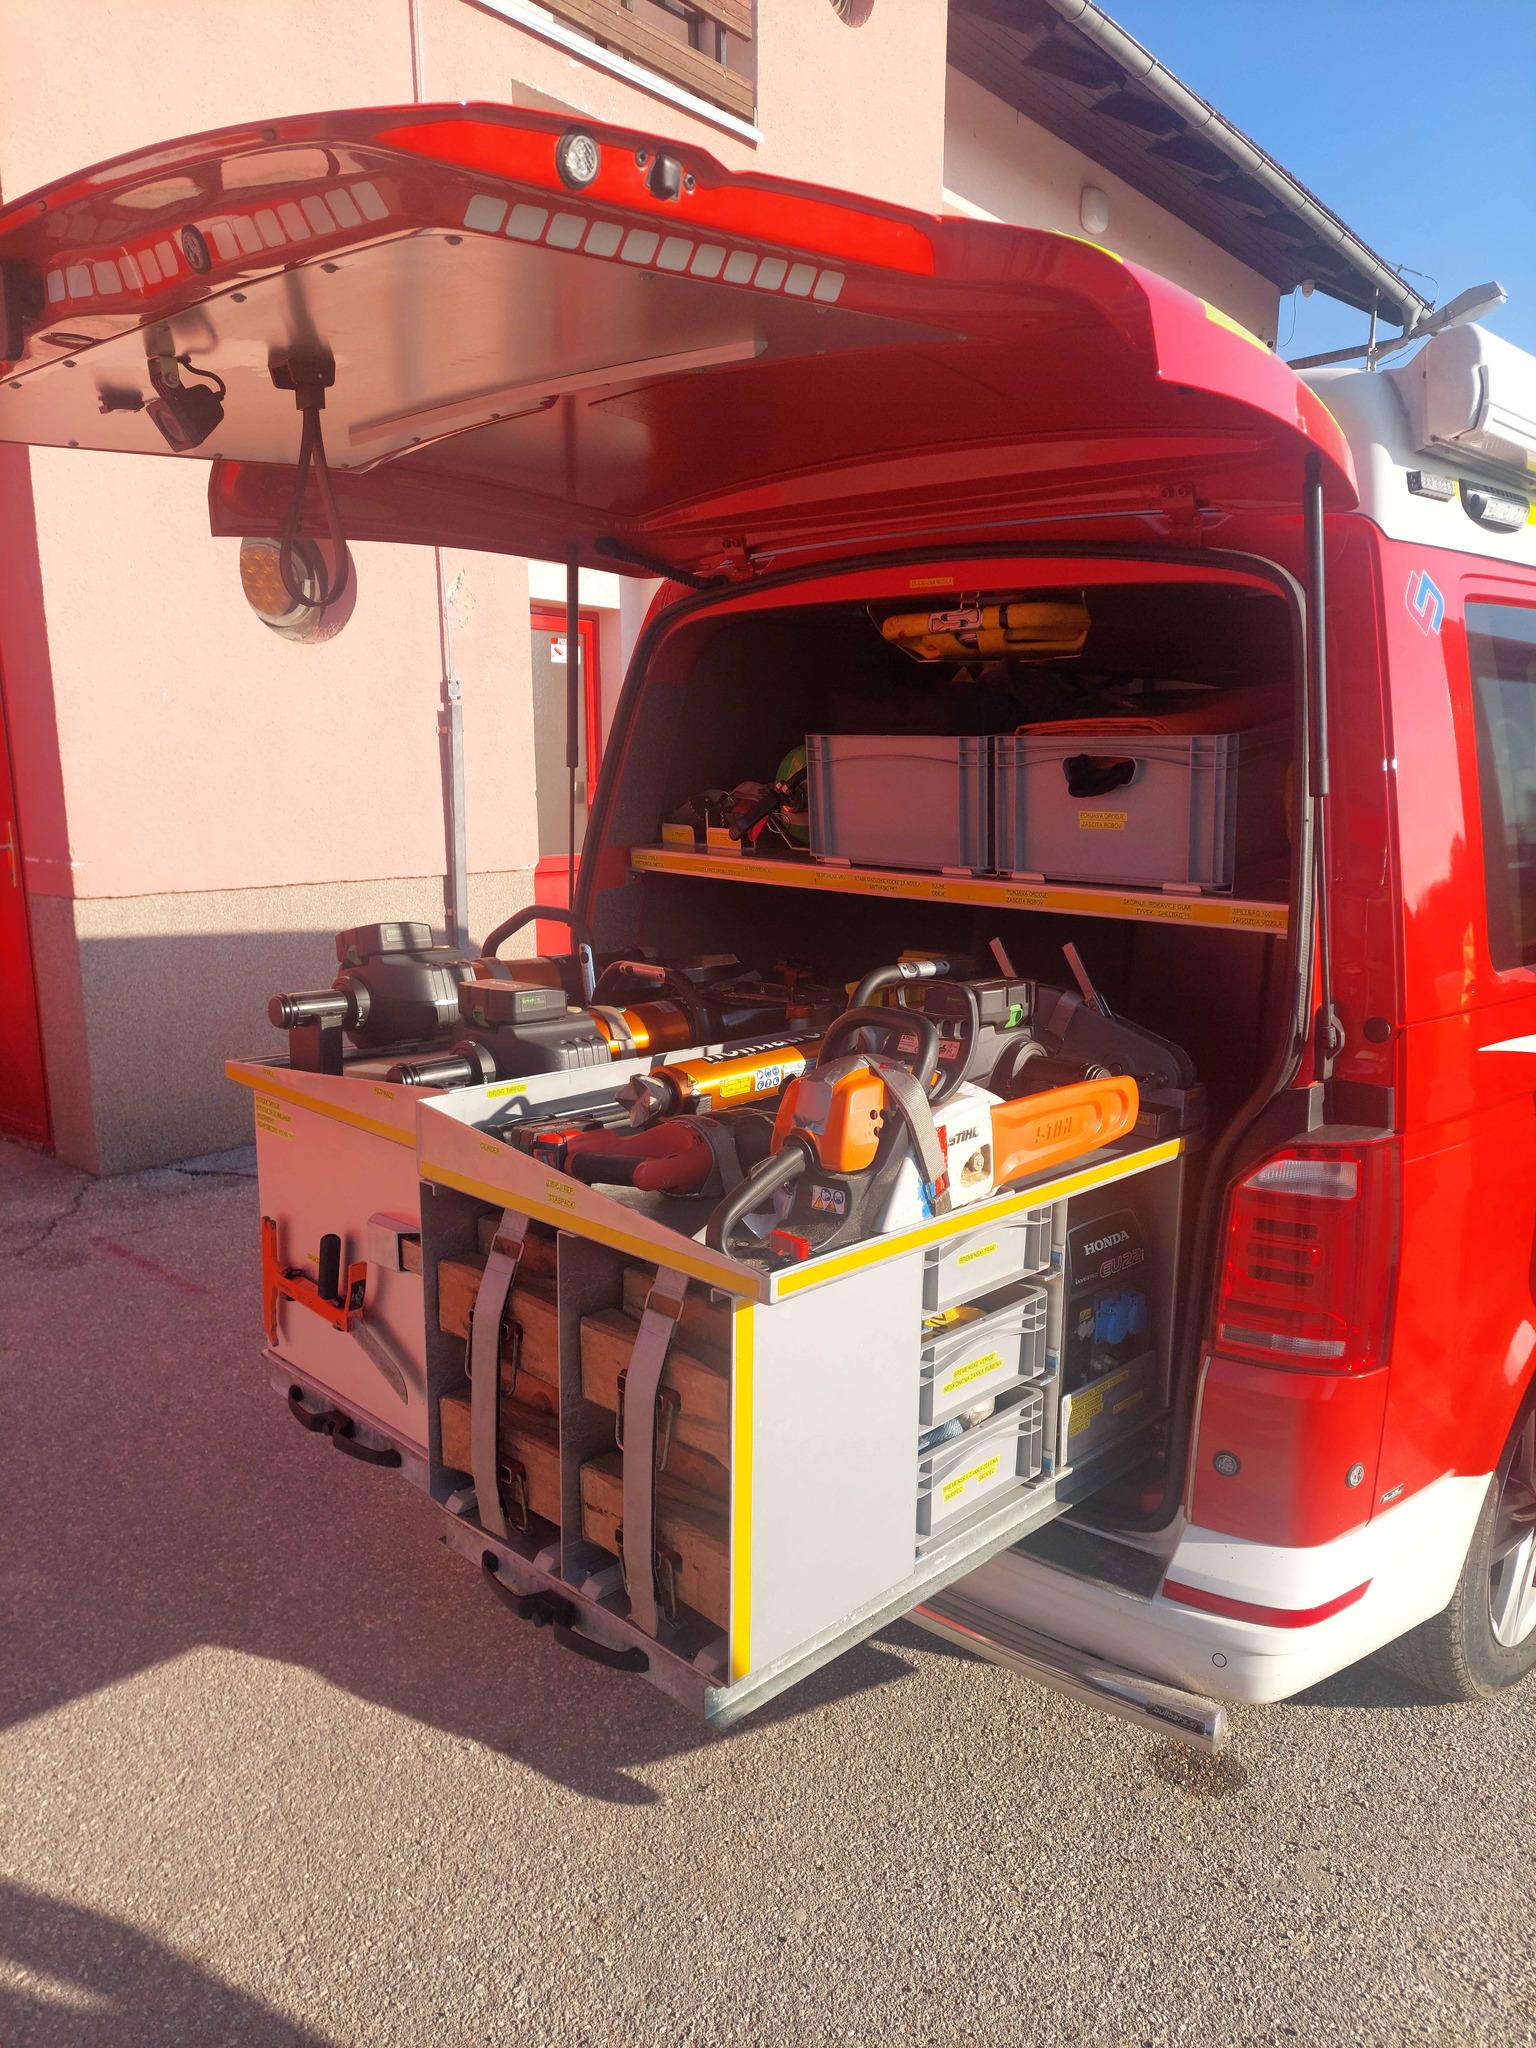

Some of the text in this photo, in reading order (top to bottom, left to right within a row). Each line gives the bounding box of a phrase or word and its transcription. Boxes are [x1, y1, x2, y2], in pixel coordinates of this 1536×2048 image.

[1136, 908, 1154, 916] TYVEK
[1232, 917, 1261, 926] ZAGOZDA
[488, 1084, 527, 1097] DROG TIRFOR
[947, 1125, 979, 1146] STIHL
[1083, 1230, 1130, 1256] HONDA
[958, 1249, 984, 1264] BREMENSKI
[1099, 1248, 1144, 1278] EU22i
[1153, 1704, 1198, 1729] bullbars.si
